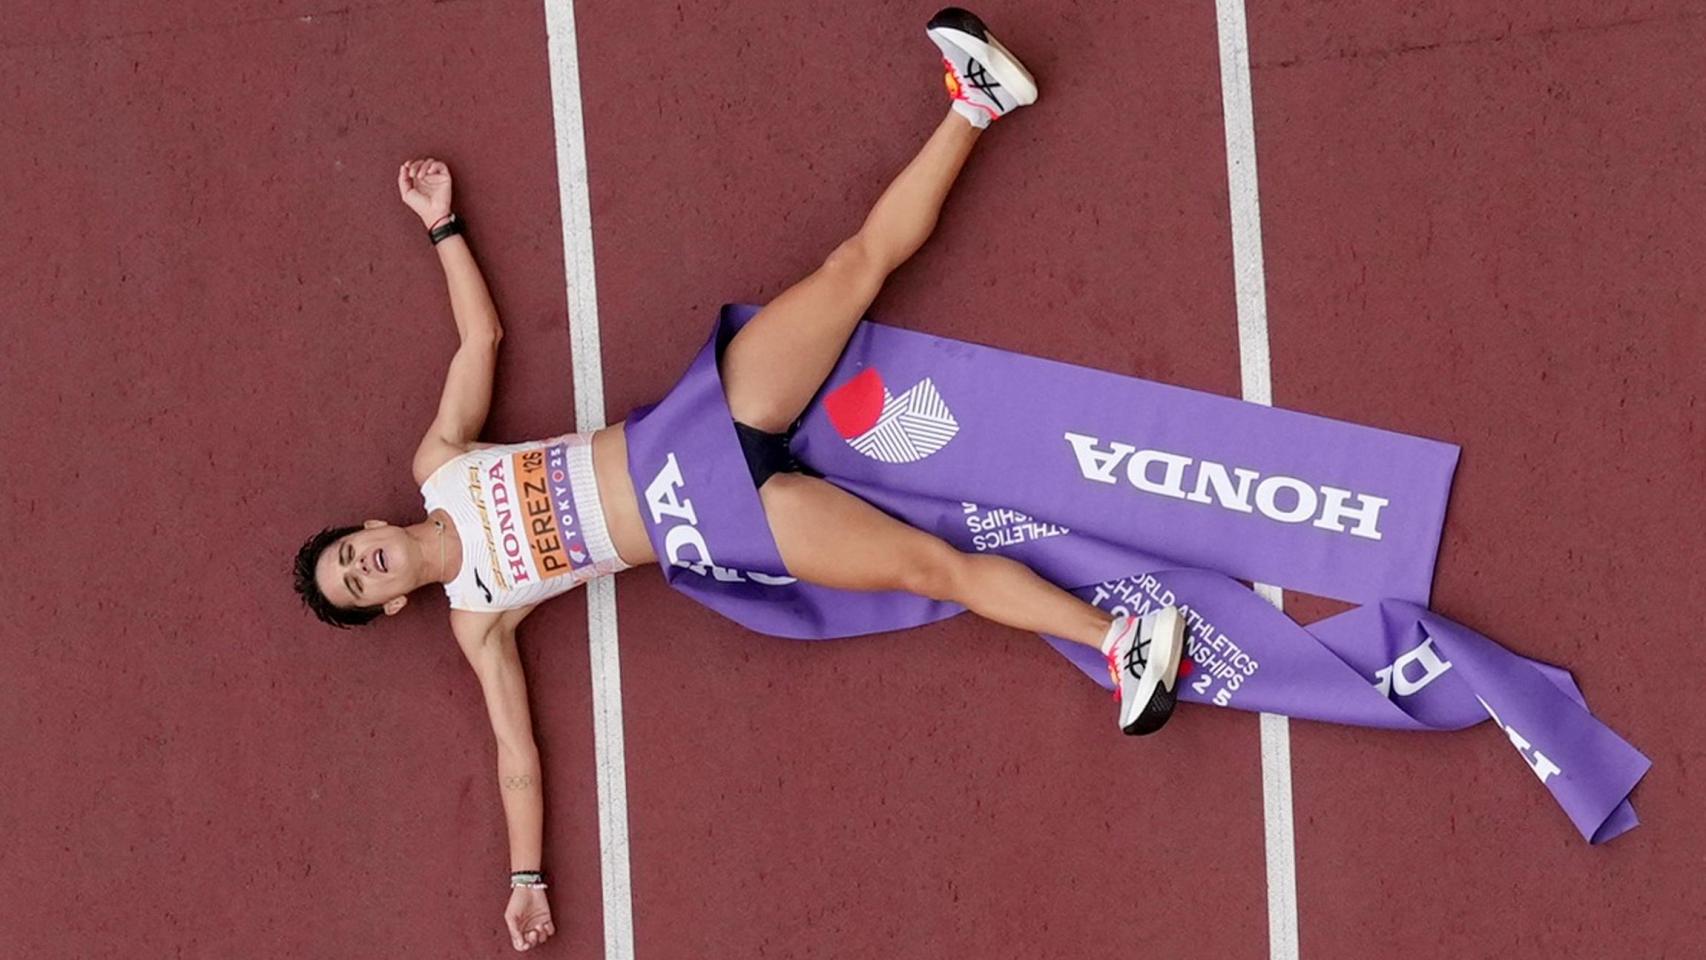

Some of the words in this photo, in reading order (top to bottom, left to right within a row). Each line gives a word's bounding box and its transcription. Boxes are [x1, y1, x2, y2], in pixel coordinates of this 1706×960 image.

[522, 451, 542, 473] 126
[1064, 432, 1388, 540] HONDA
[489, 459, 530, 583] HONDA
[523, 477, 568, 572] PÉREZ
[1131, 573, 1176, 608] ORLD
[1177, 604, 1259, 676] ATHLETICS
